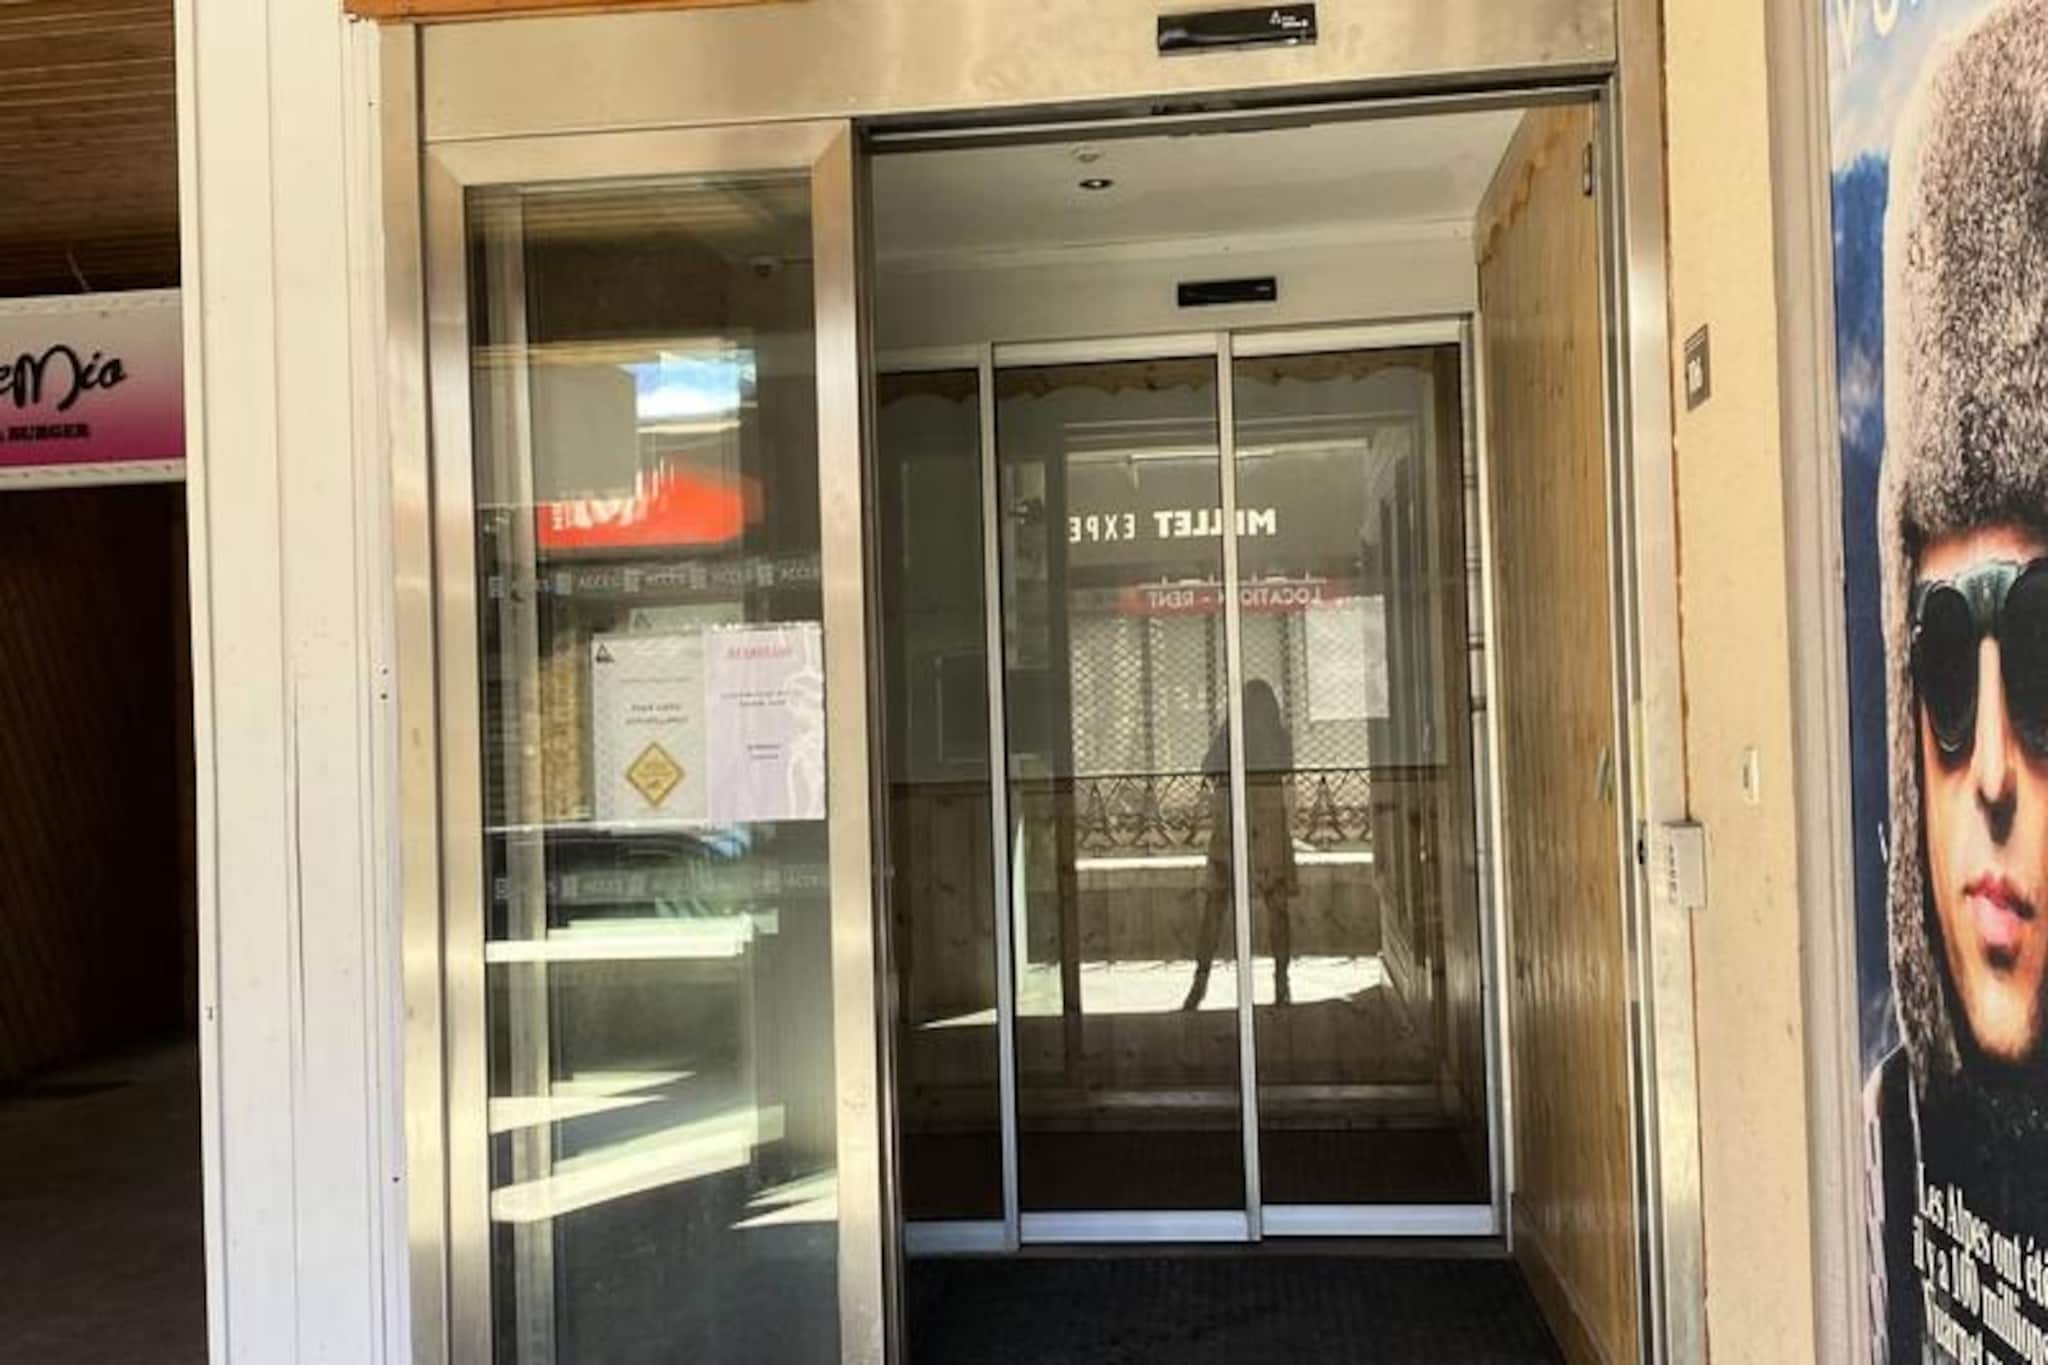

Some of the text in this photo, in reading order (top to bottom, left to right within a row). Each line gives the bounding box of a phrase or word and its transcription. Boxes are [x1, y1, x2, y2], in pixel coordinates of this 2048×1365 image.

[8, 423, 89, 442] BURGER
[1916, 1162, 1945, 1229] Les
[1946, 1183, 1990, 1265] Alpes
[1993, 1231, 2024, 1290] ont
[1937, 1250, 1950, 1293] a
[1951, 1246, 1980, 1317] 100
